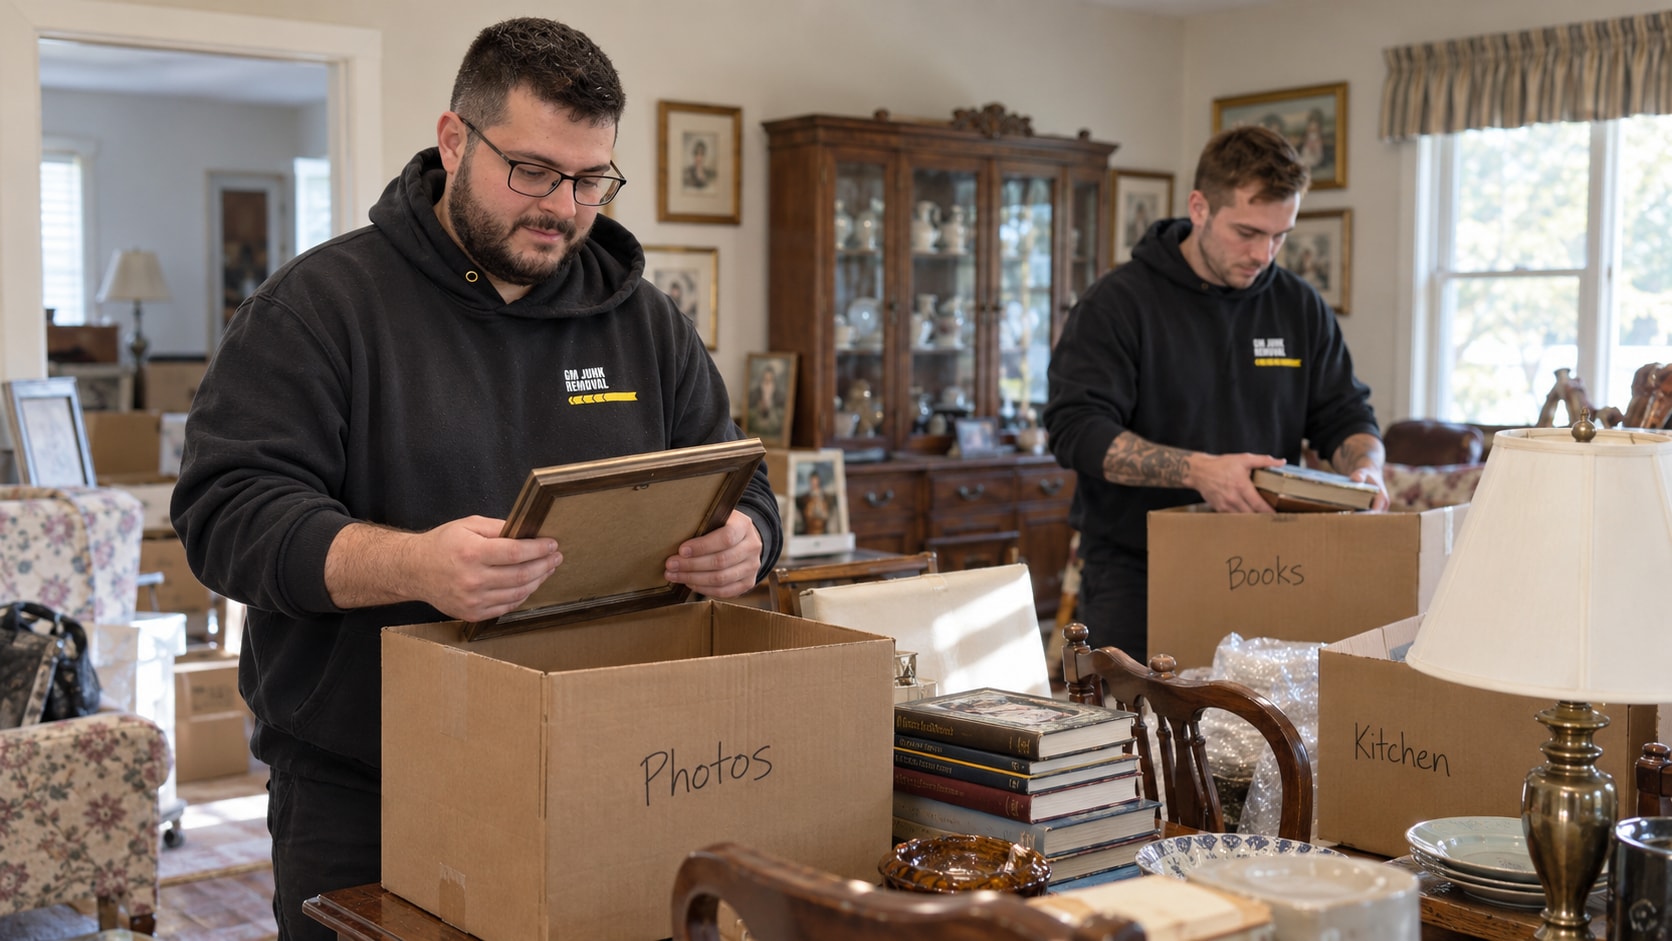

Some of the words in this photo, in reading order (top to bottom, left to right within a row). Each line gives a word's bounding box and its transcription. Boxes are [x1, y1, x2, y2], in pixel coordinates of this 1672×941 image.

[1254, 347, 1286, 357] REMOVAL
[564, 369, 579, 380] GM
[581, 367, 605, 379] JUNK
[565, 378, 609, 392] REMOVAL
[1225, 555, 1304, 591] Books
[1355, 722, 1450, 777] Kitchen
[640, 741, 772, 806] Photos
